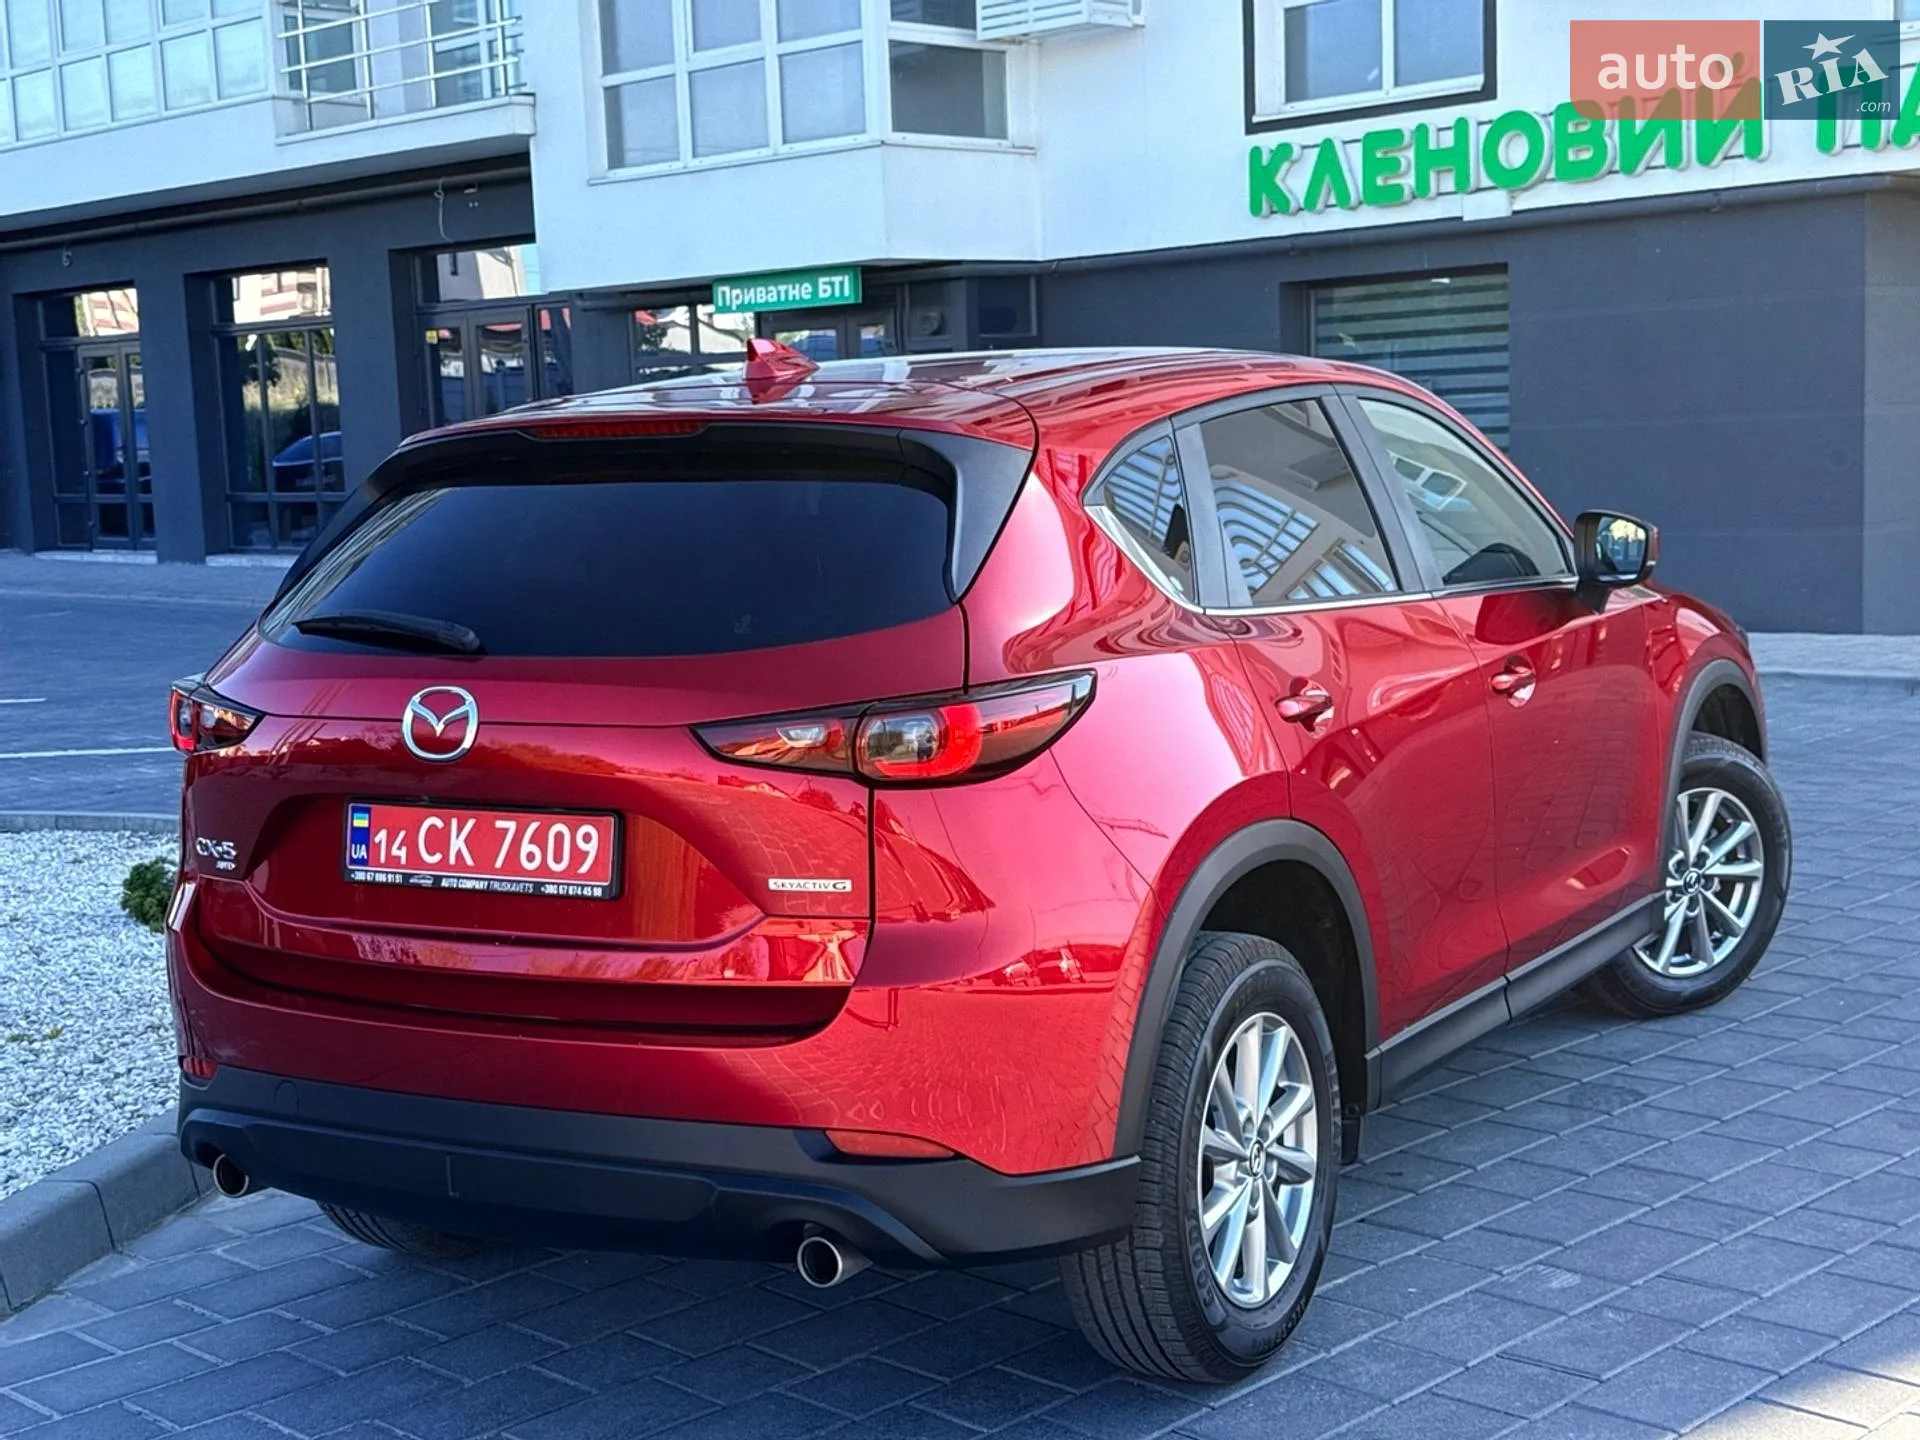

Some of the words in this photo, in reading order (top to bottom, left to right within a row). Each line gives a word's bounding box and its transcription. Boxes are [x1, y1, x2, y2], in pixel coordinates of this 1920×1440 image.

[1249, 52, 1764, 217] КЛЕНОВИЙ
[717, 282, 813, 310] Приватне
[817, 274, 850, 299] БТІ
[196, 837, 237, 860] CX-5
[351, 843, 368, 860] UA
[373, 828, 407, 865] 14
[418, 816, 477, 867] CK
[494, 819, 599, 874] 7609
[441, 877, 458, 888] AUTO
[458, 878, 489, 891] COMPANY
